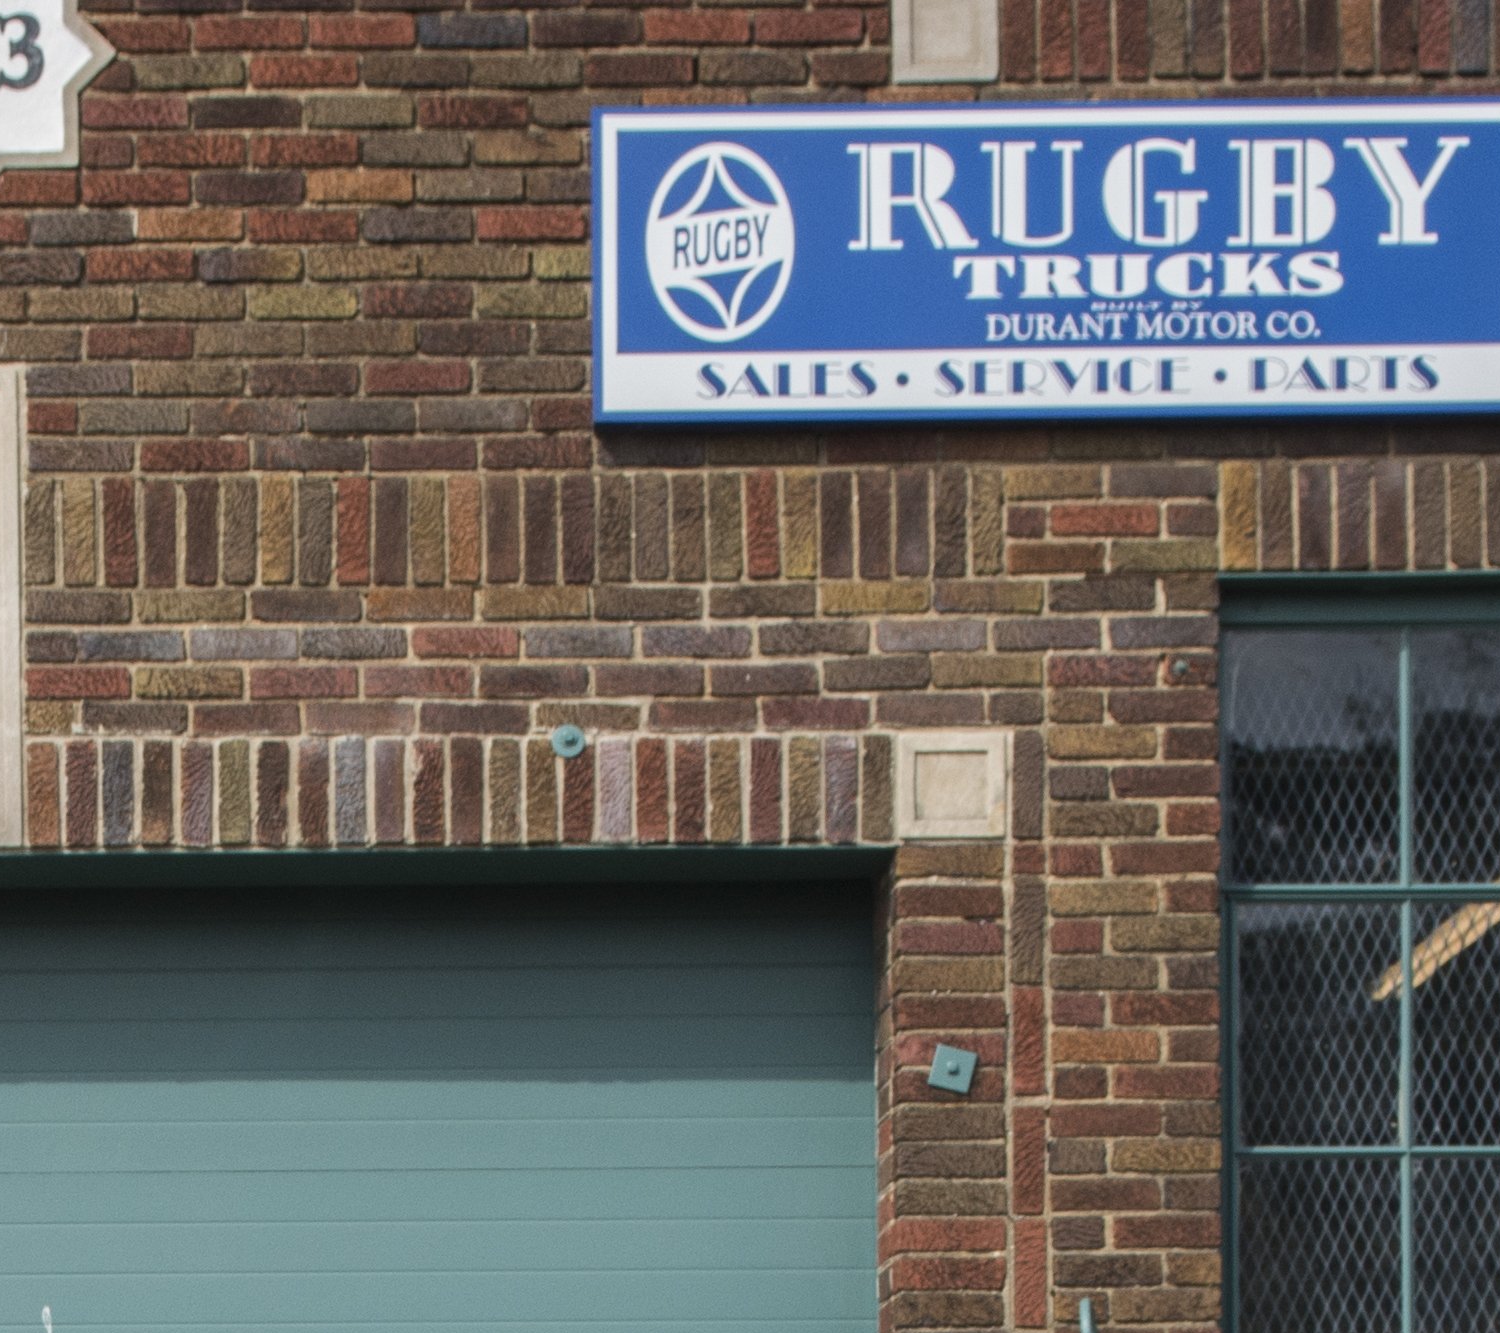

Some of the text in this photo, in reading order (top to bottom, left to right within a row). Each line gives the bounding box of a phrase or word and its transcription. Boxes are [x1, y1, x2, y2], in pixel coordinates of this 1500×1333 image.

[846, 136, 1471, 251] RUGBY
[672, 213, 771, 271] RUGBY
[953, 251, 1345, 300] TRUCKS
[985, 309, 1321, 342] DURANT MOTOR CO.
[696, 353, 1440, 400] SALES SERVICE PARTS
